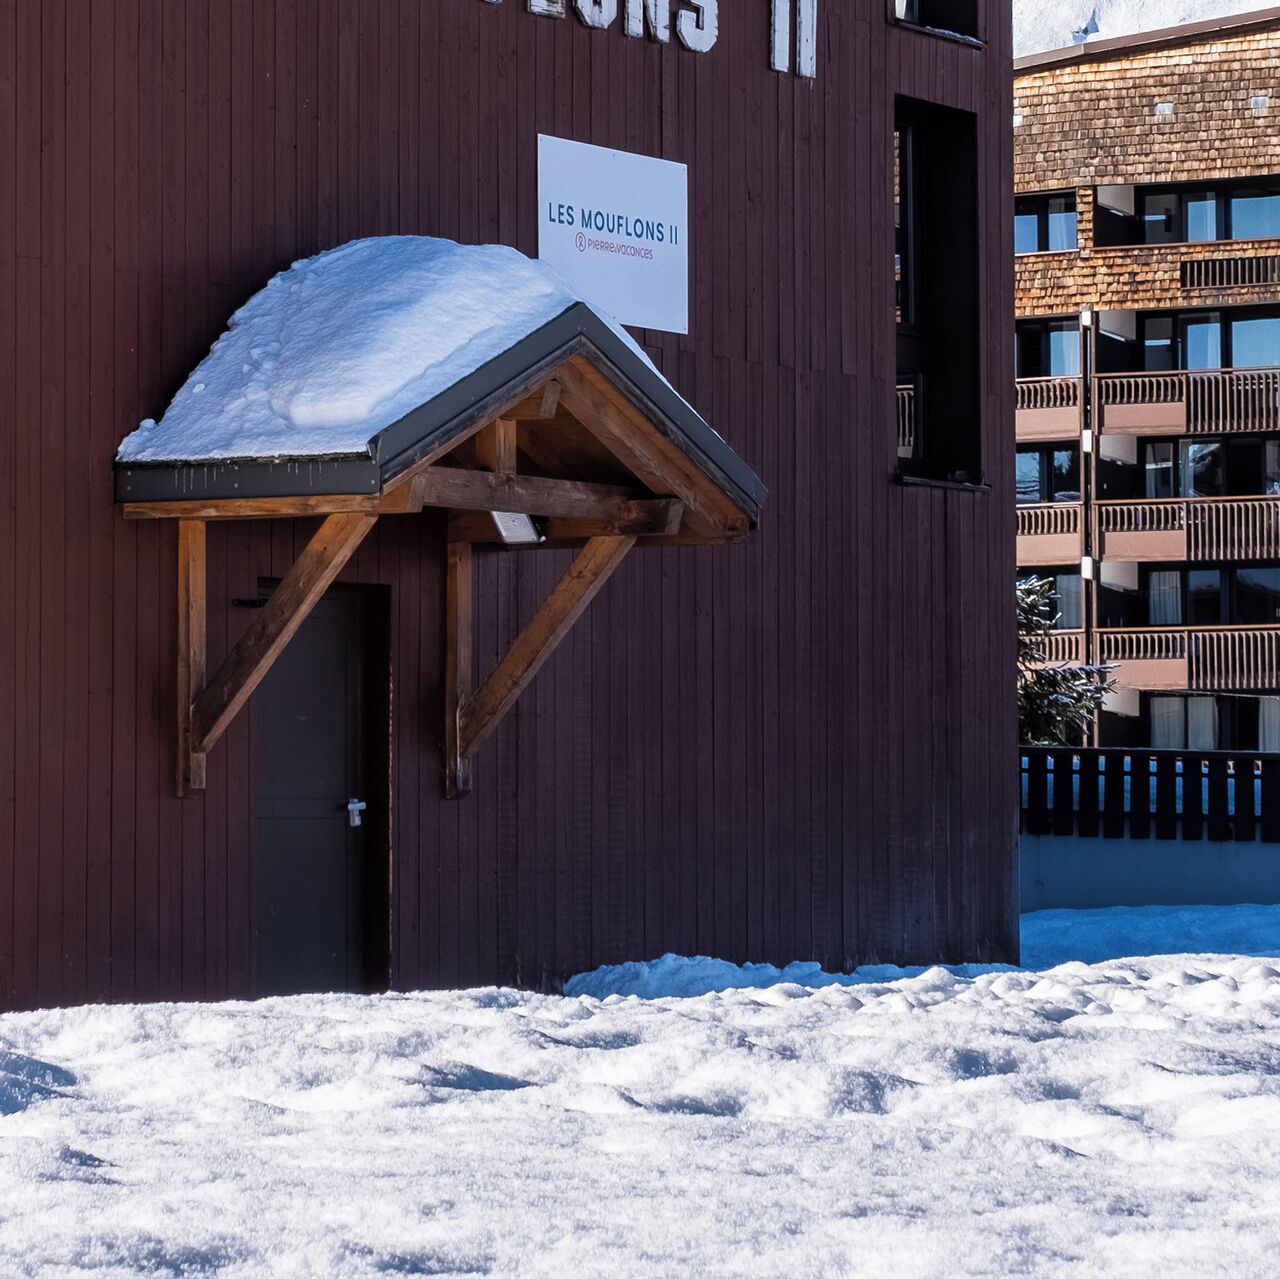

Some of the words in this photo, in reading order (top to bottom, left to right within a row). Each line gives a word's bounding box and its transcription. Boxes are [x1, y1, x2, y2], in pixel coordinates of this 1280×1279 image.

[548, 202, 575, 226] LES
[581, 208, 664, 242] MOUFLONS
[669, 225, 678, 245] II
